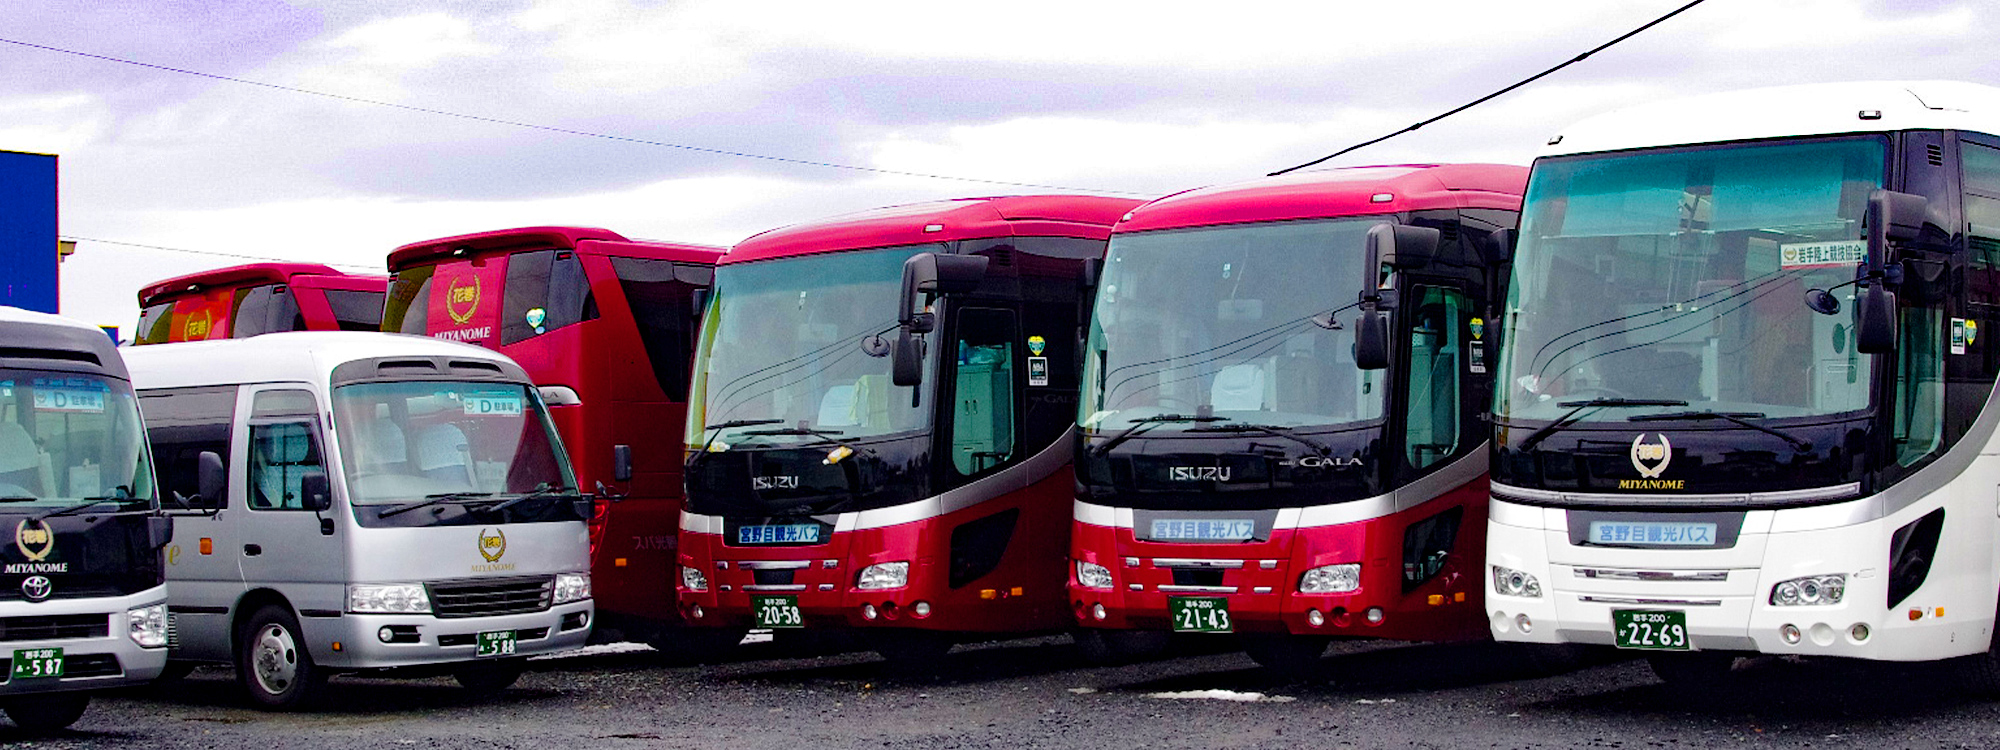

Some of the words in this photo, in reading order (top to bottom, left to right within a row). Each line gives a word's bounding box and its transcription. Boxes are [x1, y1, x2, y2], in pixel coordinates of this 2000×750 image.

[453, 286, 475, 303] 花巻
[54, 391, 67, 408] D
[480, 399, 492, 413] D
[1299, 456, 1363, 467] GALA
[1169, 466, 1231, 482] ISUZU
[752, 475, 799, 491] ISUZU
[1618, 479, 1686, 490] MIYANOME
[740, 526, 819, 543] 宮野目観光バス
[1154, 521, 1255, 539] 宮野目観光バス
[1599, 525, 1709, 542] 宮野目観光バス
[4, 562, 69, 574] MIYANOME
[471, 563, 516, 573] MIYANOME
[1181, 607, 1229, 630] 21-43
[1648, 613, 1666, 623] 200
[1627, 621, 1685, 647] 22-69
